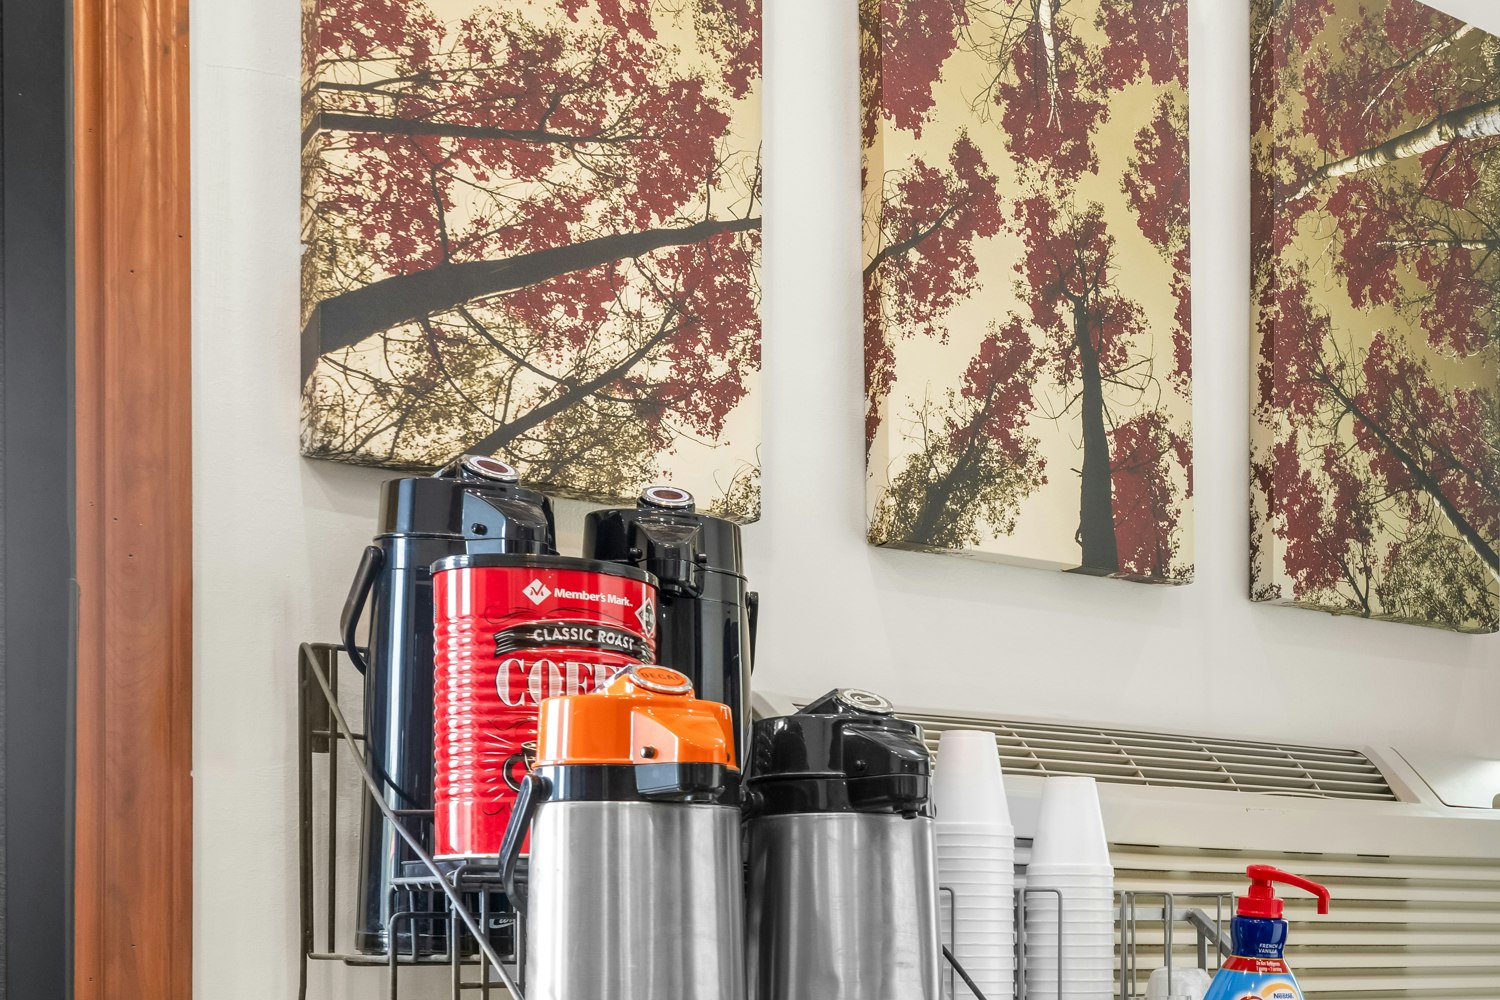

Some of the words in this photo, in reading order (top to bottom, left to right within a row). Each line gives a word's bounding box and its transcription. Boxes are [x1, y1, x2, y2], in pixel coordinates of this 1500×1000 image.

[554, 588, 606, 602] Member's
[534, 627, 593, 641] CLASSIC
[597, 630, 634, 650] ROAST
